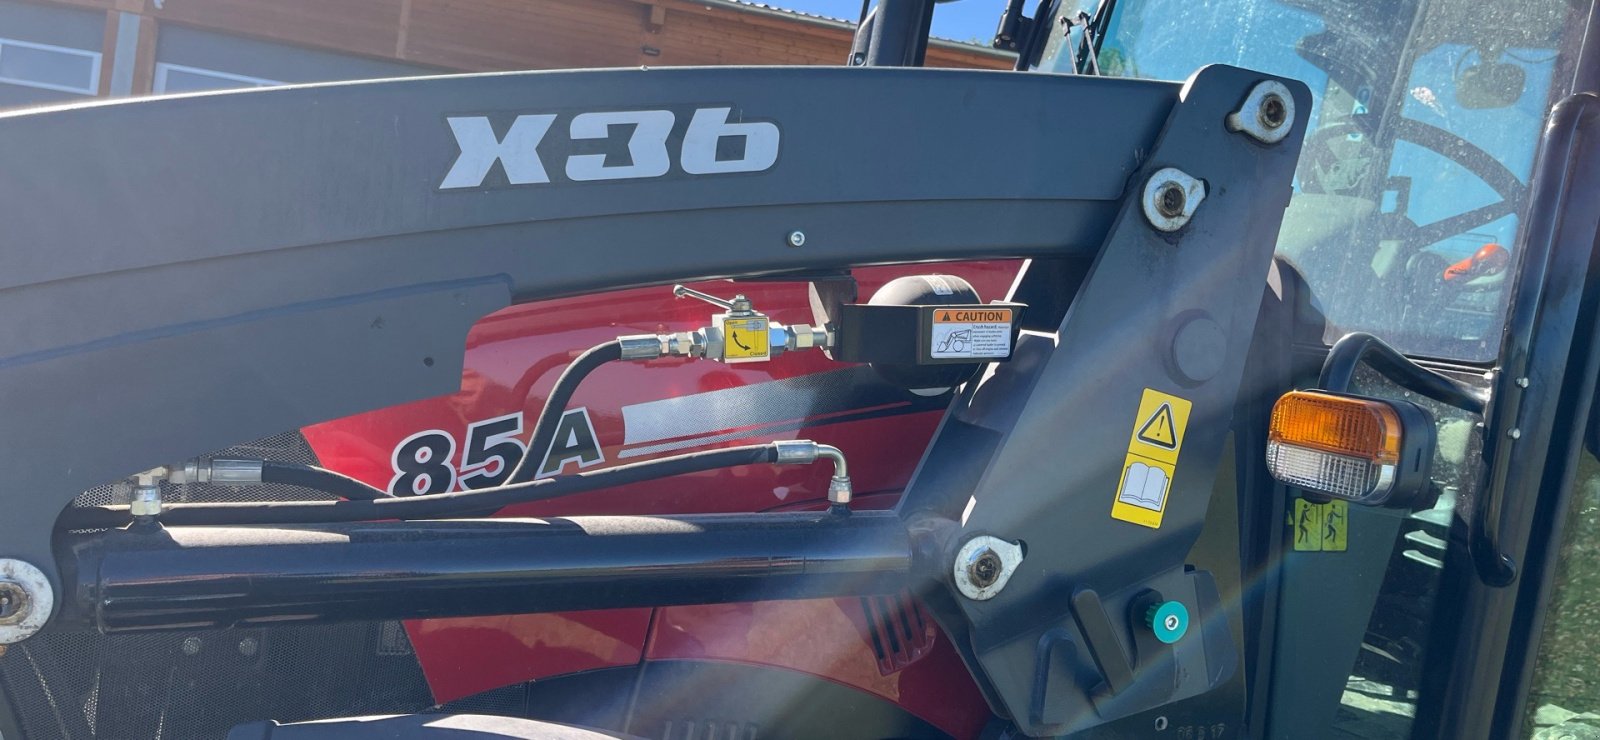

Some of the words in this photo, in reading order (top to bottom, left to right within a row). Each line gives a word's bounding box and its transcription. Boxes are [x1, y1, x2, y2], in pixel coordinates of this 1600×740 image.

[439, 107, 780, 190] X36
[955, 311, 1003, 321] CAUTION
[387, 406, 606, 498] 85A
